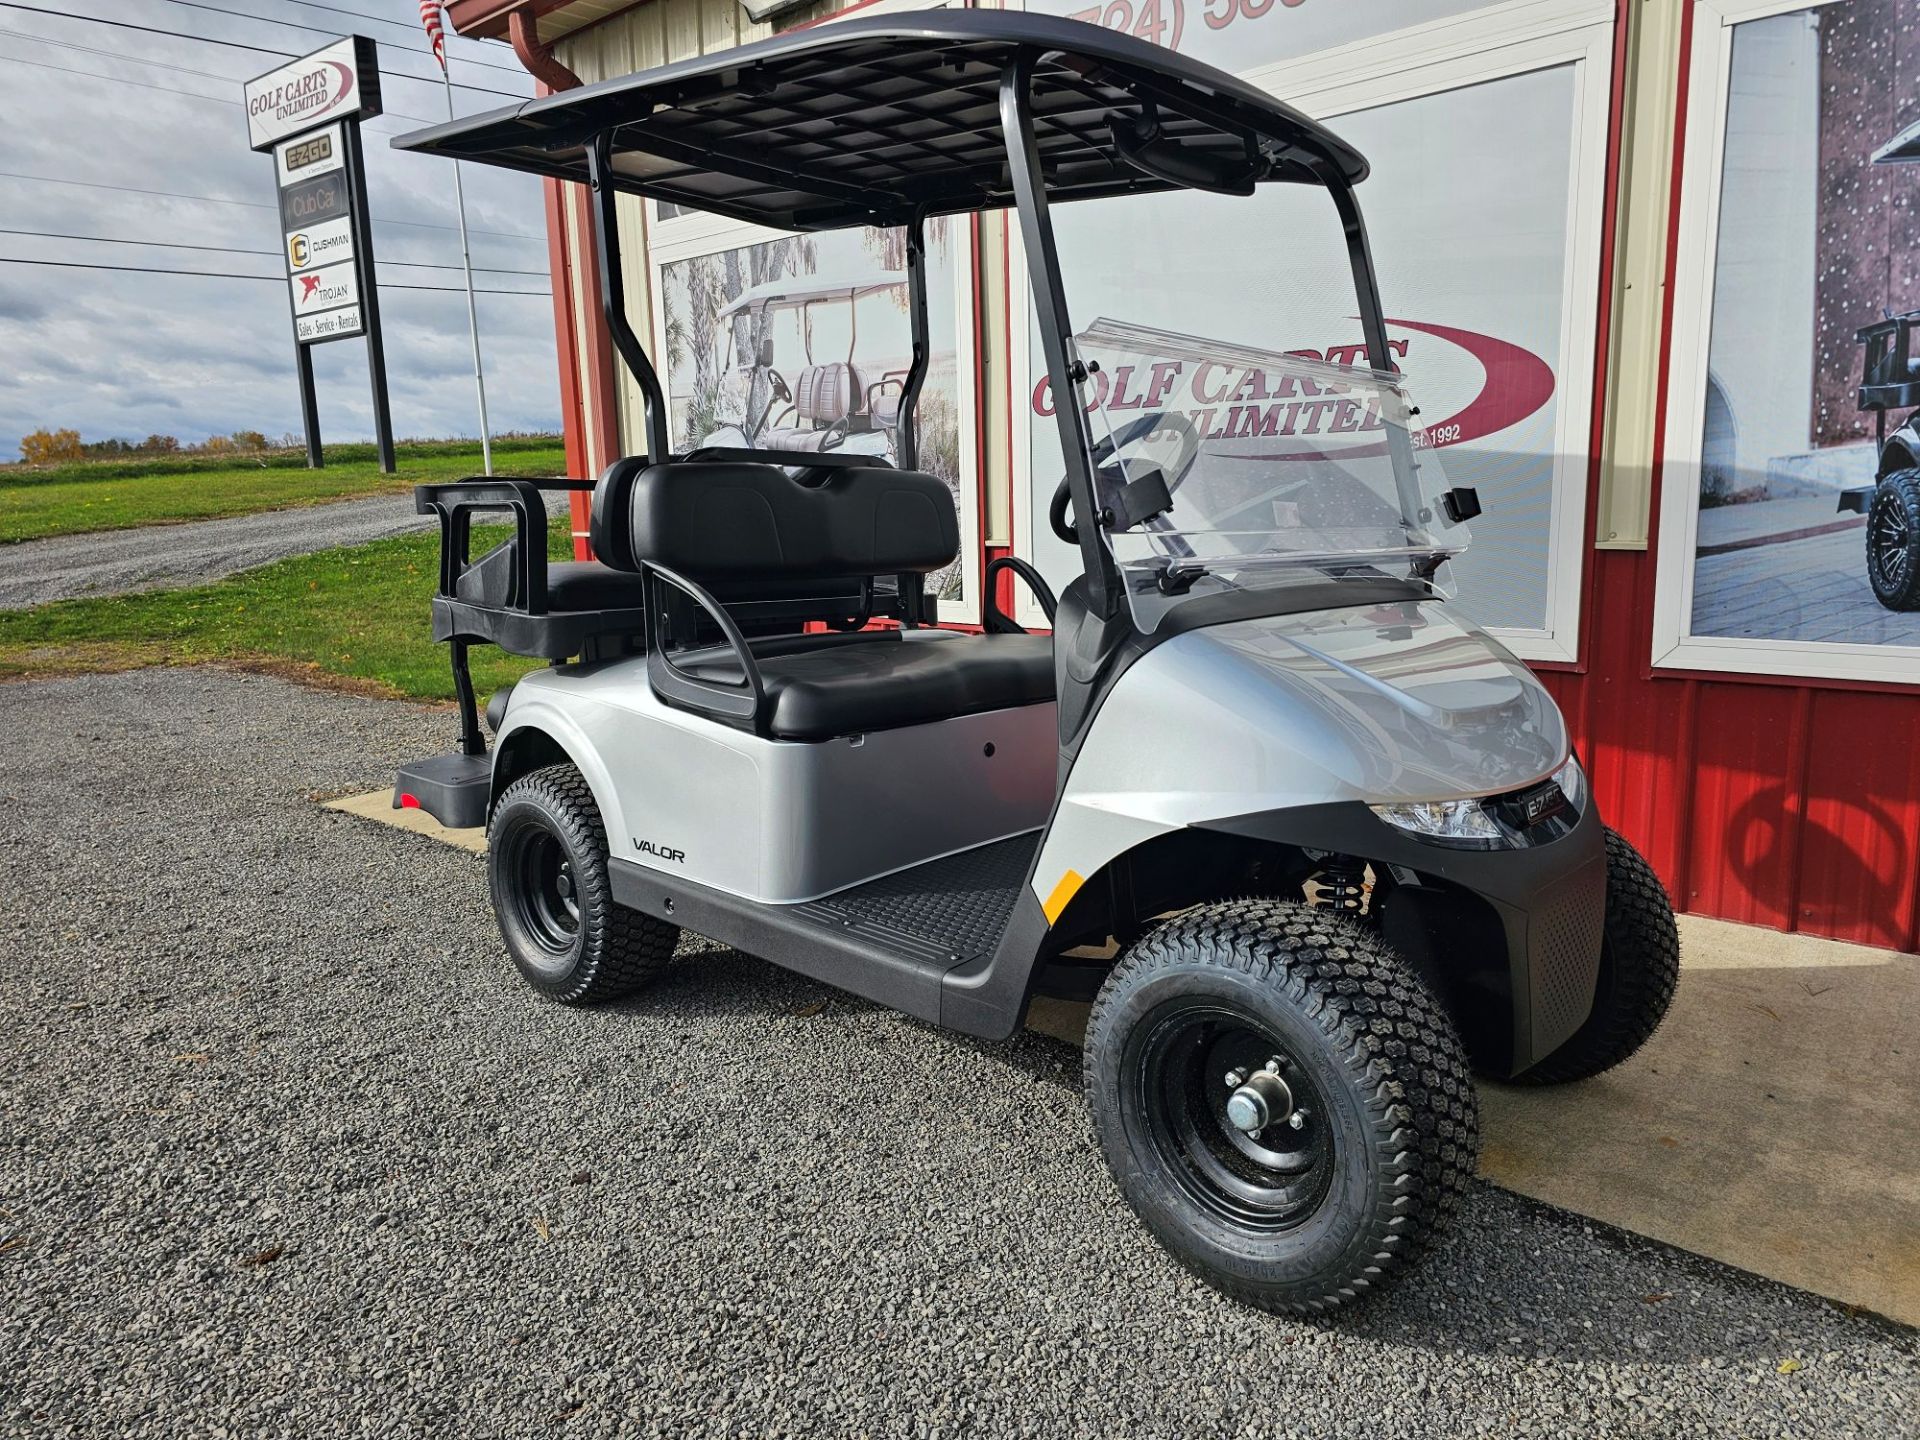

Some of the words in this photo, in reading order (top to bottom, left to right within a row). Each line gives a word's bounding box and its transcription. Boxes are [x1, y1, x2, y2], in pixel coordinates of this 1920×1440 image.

[250, 86, 283, 117] GOLF
[285, 68, 327, 101] CARTS
[276, 89, 328, 120] UNLIMITED
[293, 195, 316, 216] Club
[316, 188, 334, 210] Car
[313, 234, 349, 252] CUSHMAN
[319, 285, 348, 301] TROJAN
[299, 322, 312, 337] Sales
[315, 317, 334, 334] Service
[338, 312, 359, 330] Rentals
[1409, 432, 1428, 449] st.
[1431, 424, 1460, 445] 1992
[632, 837, 685, 864] VALOR
